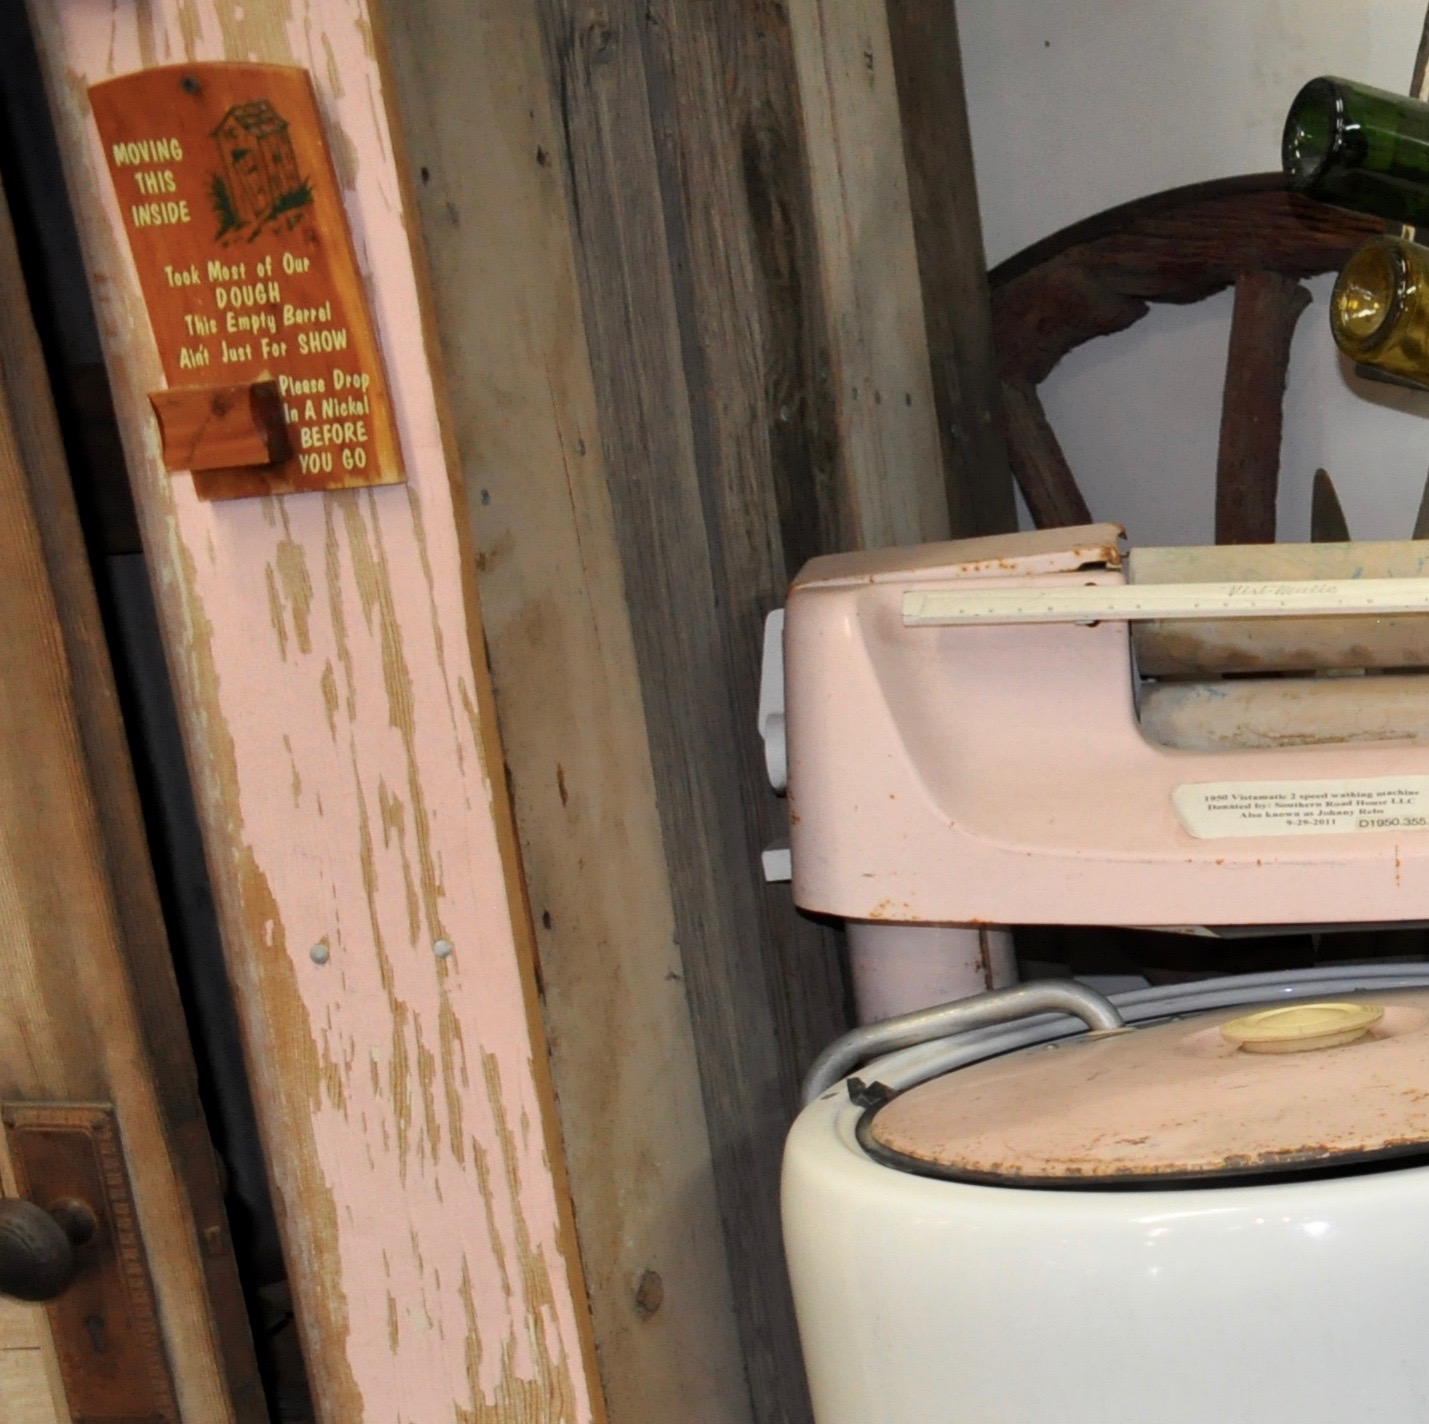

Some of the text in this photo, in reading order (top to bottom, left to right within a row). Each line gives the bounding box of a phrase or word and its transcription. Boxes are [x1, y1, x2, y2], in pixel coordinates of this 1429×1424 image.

[112, 138, 183, 166] MOVING
[134, 169, 176, 195] THIS
[131, 201, 191, 228] INSIDE
[164, 252, 310, 288] Took Most of Our
[215, 282, 281, 308] DOUGH
[185, 302, 332, 337] This Empty Barrel
[179, 328, 348, 370] Ain't Just For SHOW
[278, 368, 371, 397] Please Drop
[284, 396, 370, 424] In A Nickel
[300, 422, 369, 448] BEFORE
[299, 447, 368, 475] YOU GO
[1274, 801, 1323, 809] Southern
[1325, 800, 1353, 808] Road
[1356, 799, 1388, 807] House
[1290, 792, 1297, 800] 2
[1299, 792, 1328, 801] speed
[1331, 790, 1373, 800] washing
[1376, 789, 1420, 798] machine
[1265, 810, 1300, 819] known
[1317, 809, 1355, 818] Johnny
